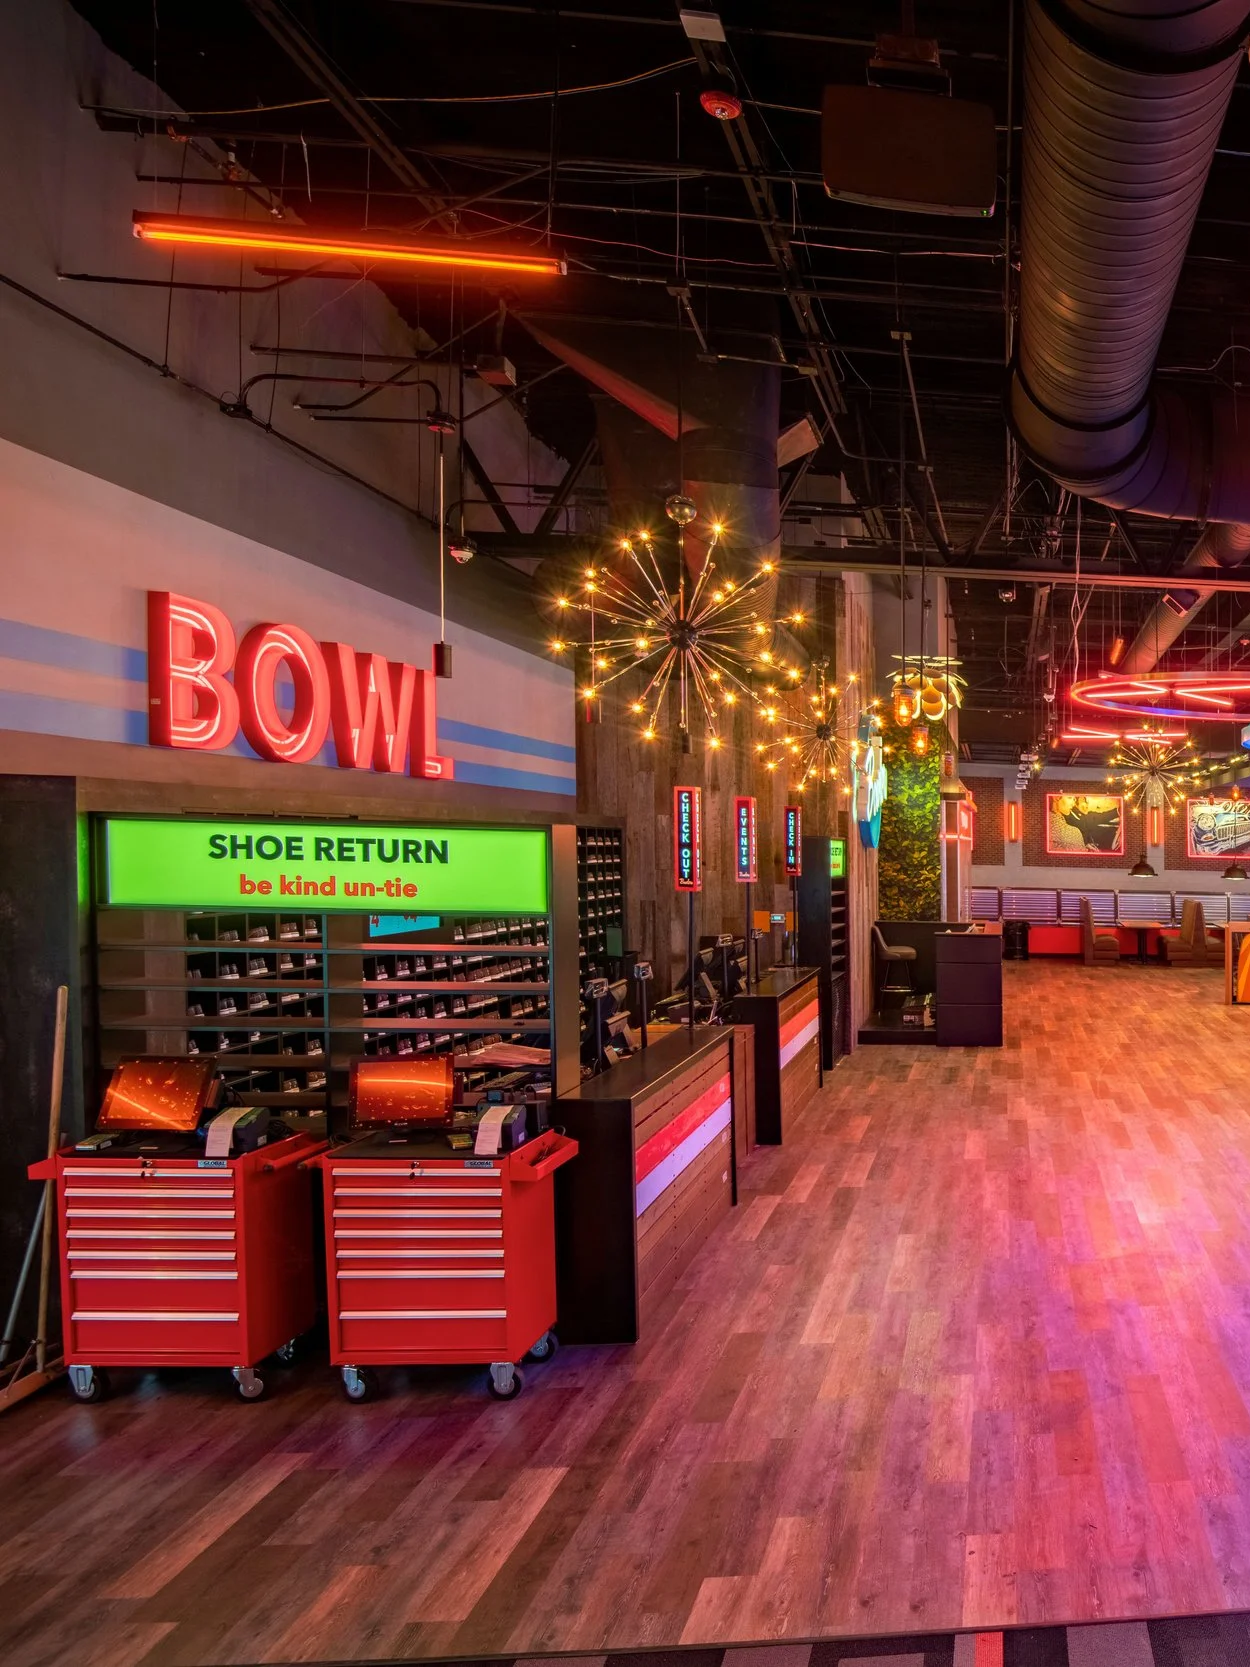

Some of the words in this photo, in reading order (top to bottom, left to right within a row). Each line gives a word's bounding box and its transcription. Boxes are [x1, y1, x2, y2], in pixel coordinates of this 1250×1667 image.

[147, 591, 454, 780] BOWL
[681, 792, 690, 843] CHECK
[208, 834, 305, 861] SHOE
[314, 837, 449, 864] RETURN
[681, 848, 690, 879] OUT
[788, 849, 795, 864] IN
[239, 873, 272, 896] be
[279, 874, 336, 896] kind
[343, 877, 418, 898] un-tie
